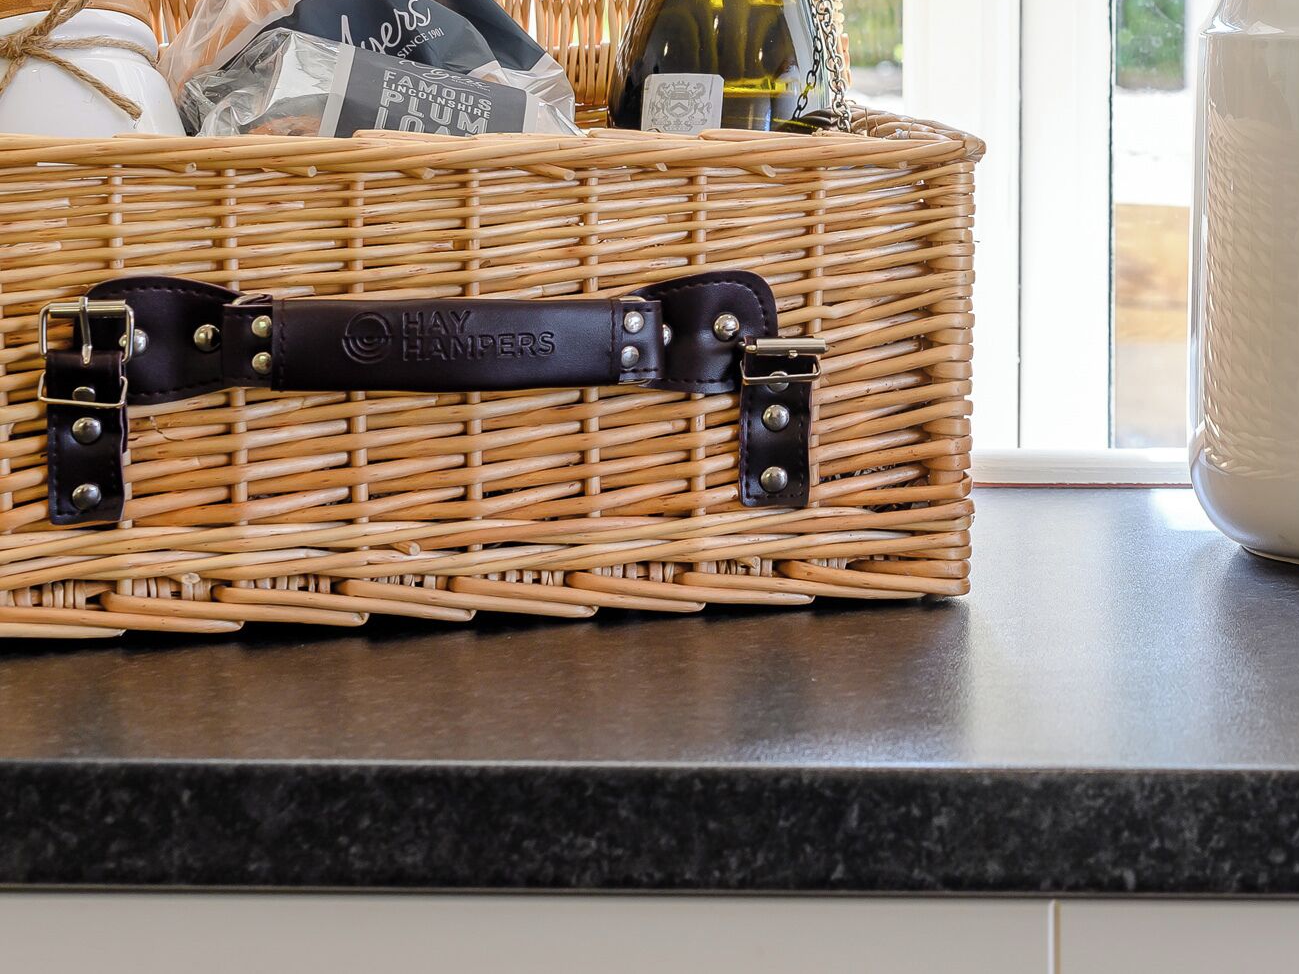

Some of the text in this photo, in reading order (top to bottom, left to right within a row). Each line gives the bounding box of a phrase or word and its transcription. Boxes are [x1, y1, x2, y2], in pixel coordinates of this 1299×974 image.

[397, 27, 445, 59] SINCE 1901
[383, 69, 492, 112] FAMOUS
[383, 81, 491, 119] LINCOLNSHIRE
[380, 88, 488, 135] PLUM
[402, 309, 472, 337] HAY
[402, 330, 556, 362] HAMPERS
